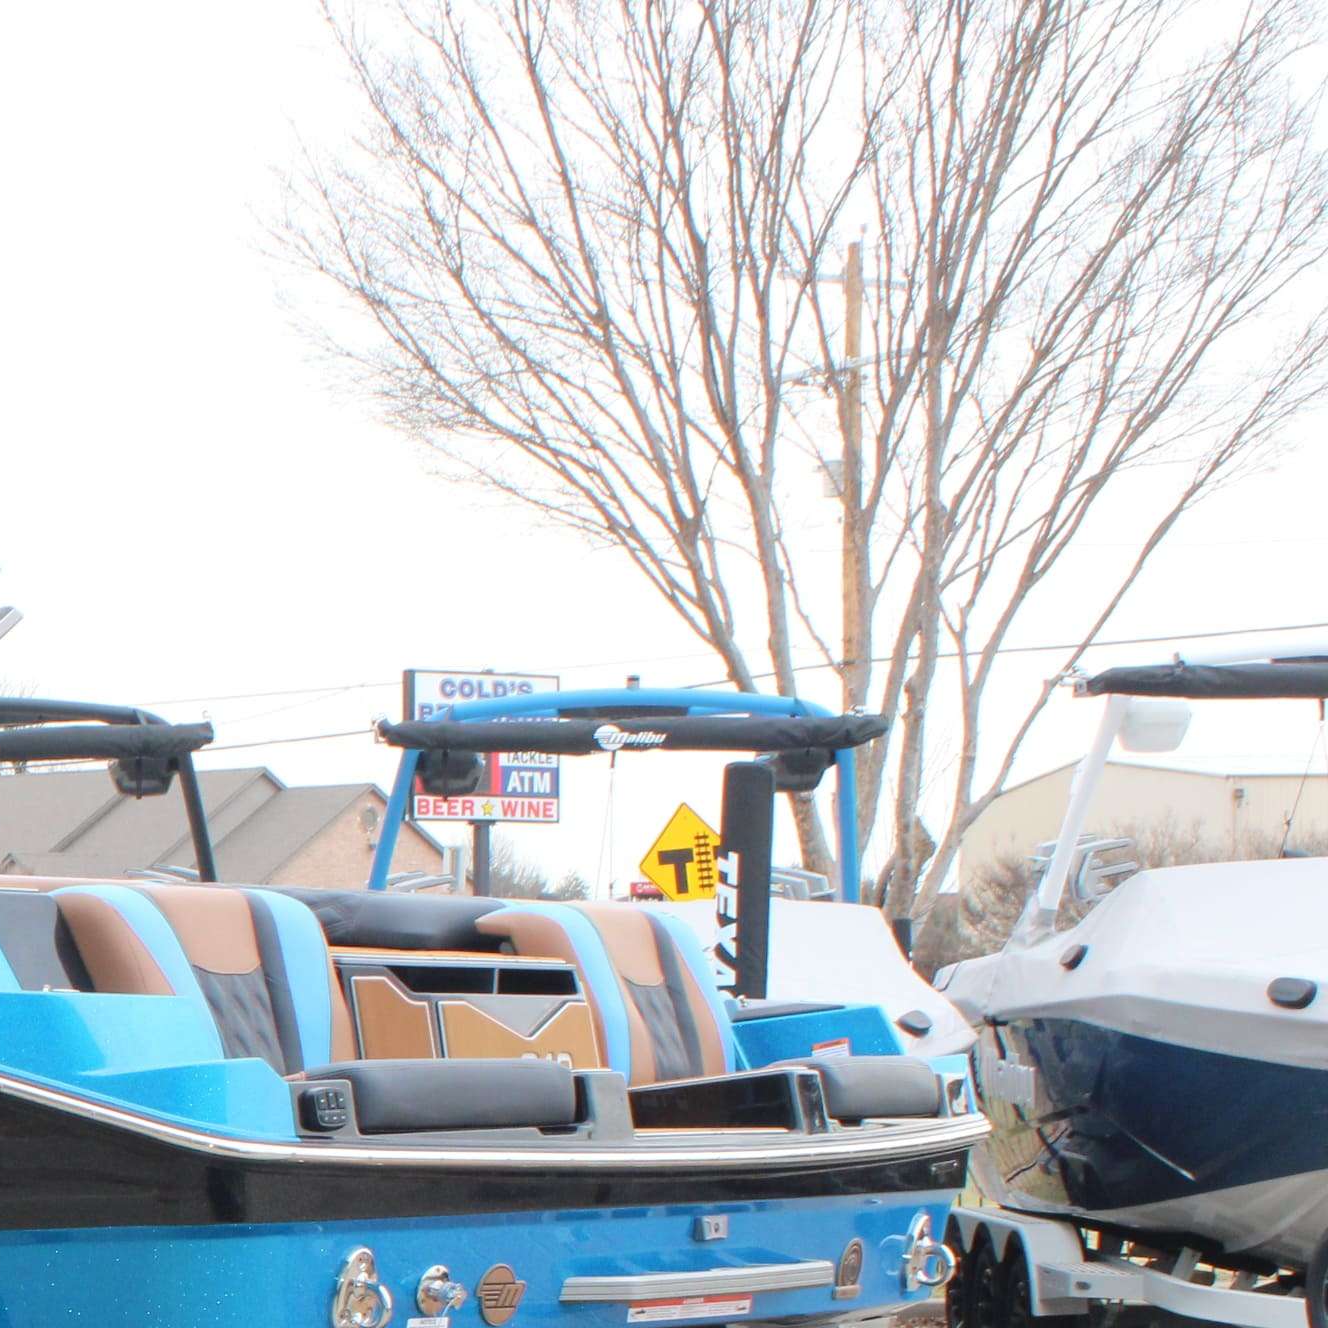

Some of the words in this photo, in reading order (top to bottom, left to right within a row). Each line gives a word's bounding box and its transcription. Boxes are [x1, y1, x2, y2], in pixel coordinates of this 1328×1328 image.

[507, 770, 551, 794] ATM
[417, 799, 475, 816] BEER
[501, 800, 555, 818] WINE
